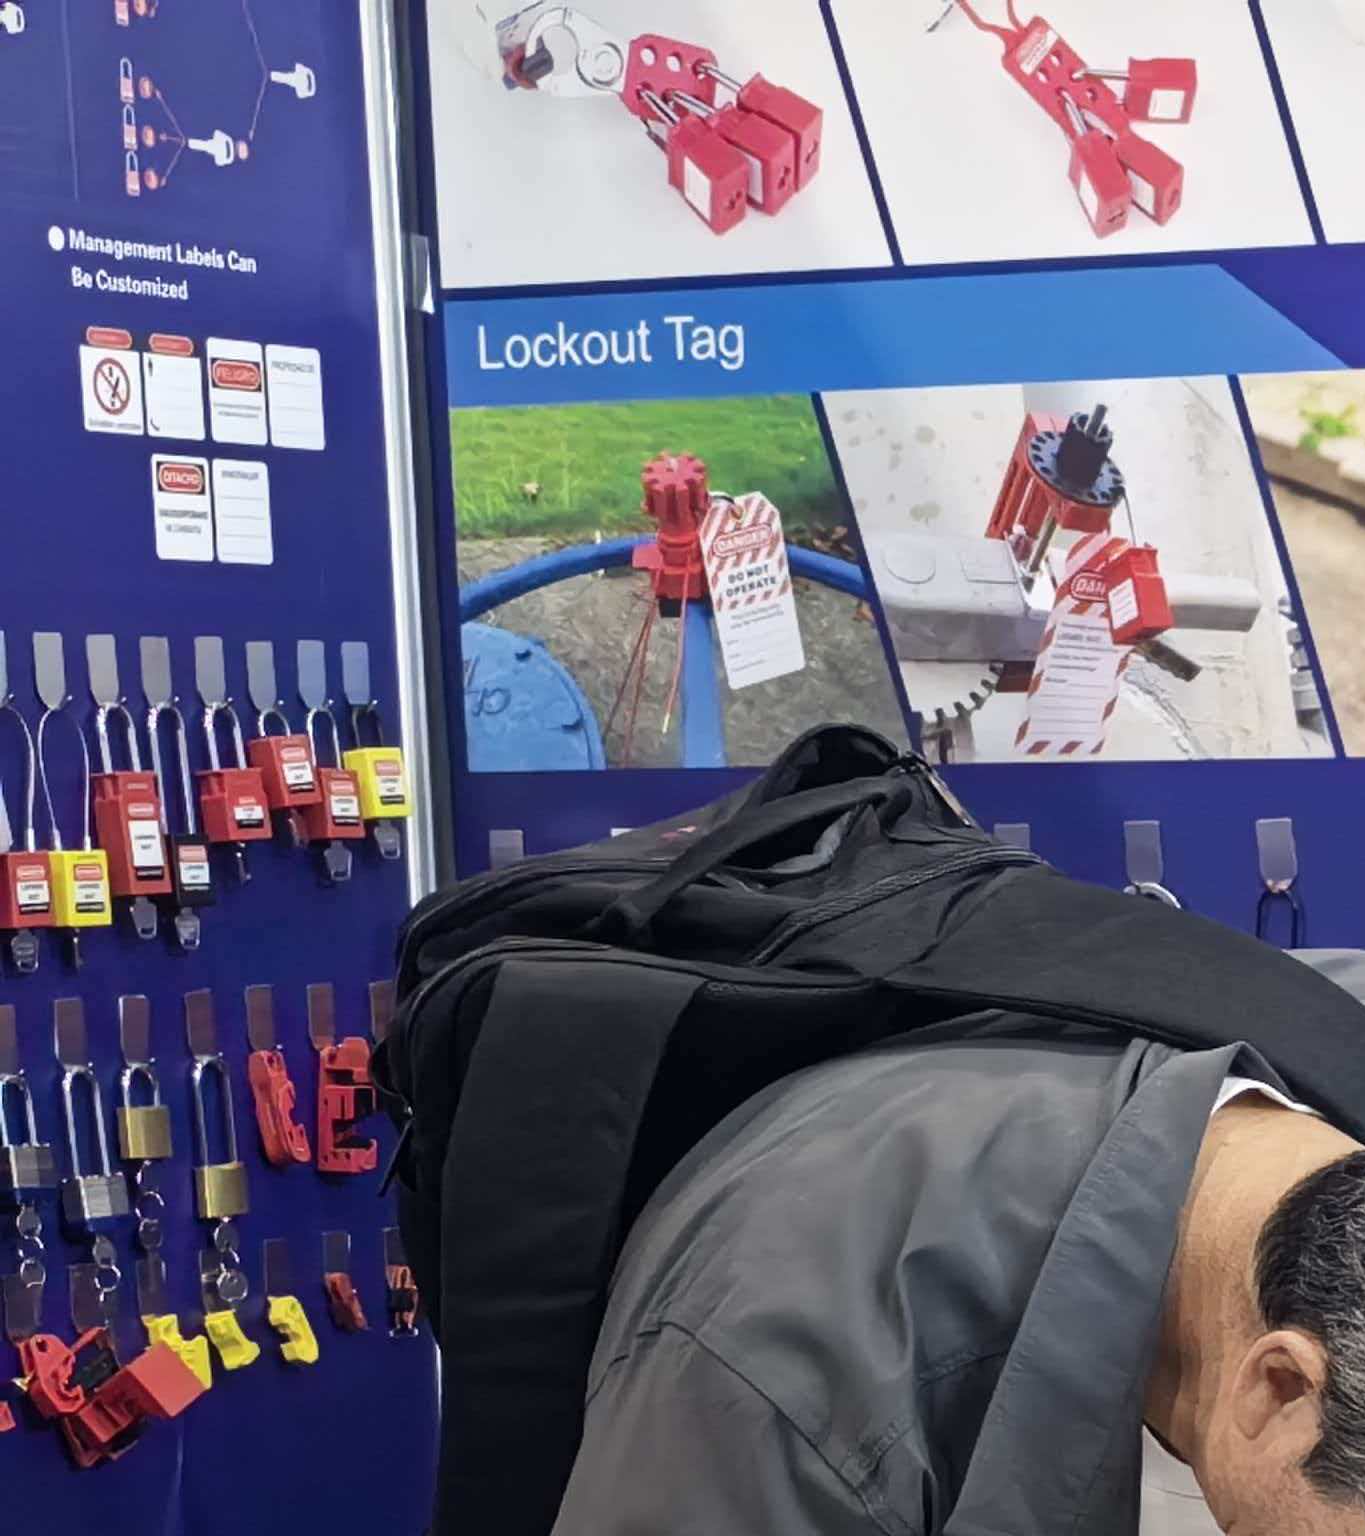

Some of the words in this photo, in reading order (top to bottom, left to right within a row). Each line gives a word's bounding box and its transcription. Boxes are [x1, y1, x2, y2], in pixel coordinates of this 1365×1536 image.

[69, 228, 173, 262] Management
[176, 242, 225, 269] Labels
[227, 250, 257, 274] Can
[71, 266, 93, 289] Be
[96, 269, 189, 301] Customized
[478, 320, 652, 370] Lockout
[664, 315, 745, 371] Tag
[726, 576, 777, 598] OPERATE
